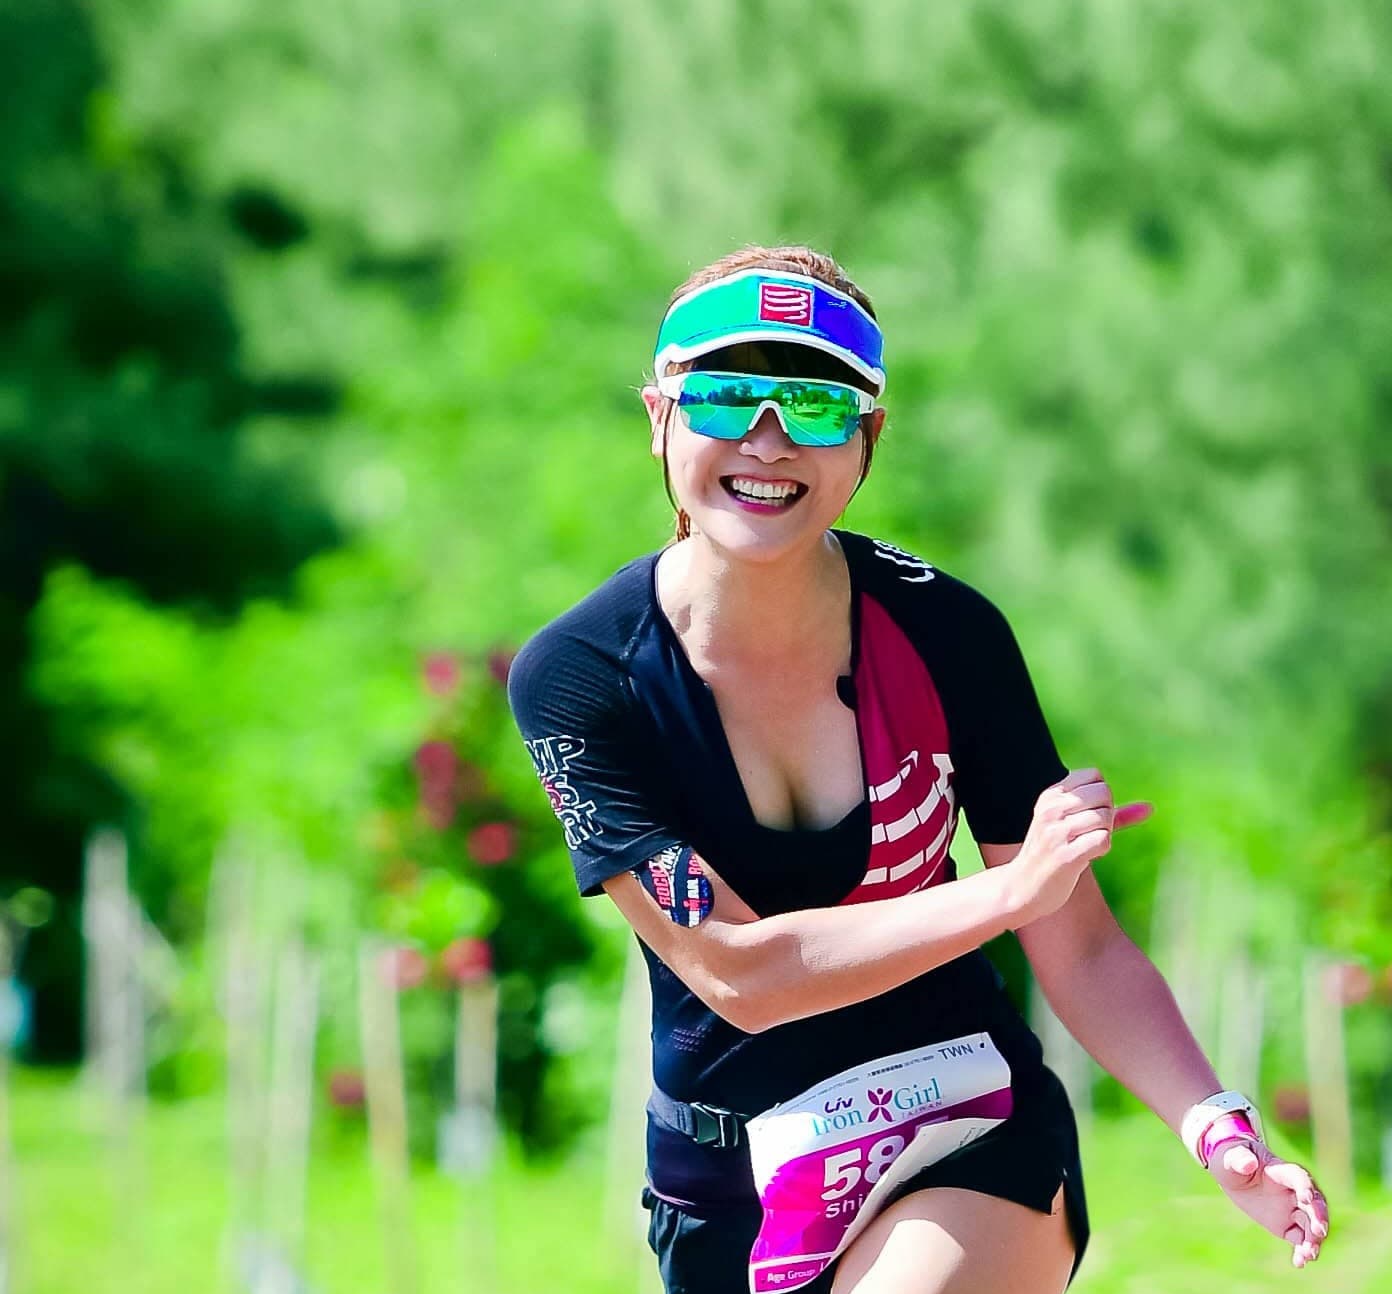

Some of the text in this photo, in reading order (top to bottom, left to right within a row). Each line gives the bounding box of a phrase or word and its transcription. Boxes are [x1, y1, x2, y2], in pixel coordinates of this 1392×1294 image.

[938, 1044, 974, 1060] TWN
[812, 1109, 864, 1136] Iron
[893, 1078, 942, 1110] Girl
[821, 1135, 906, 1201] 58
